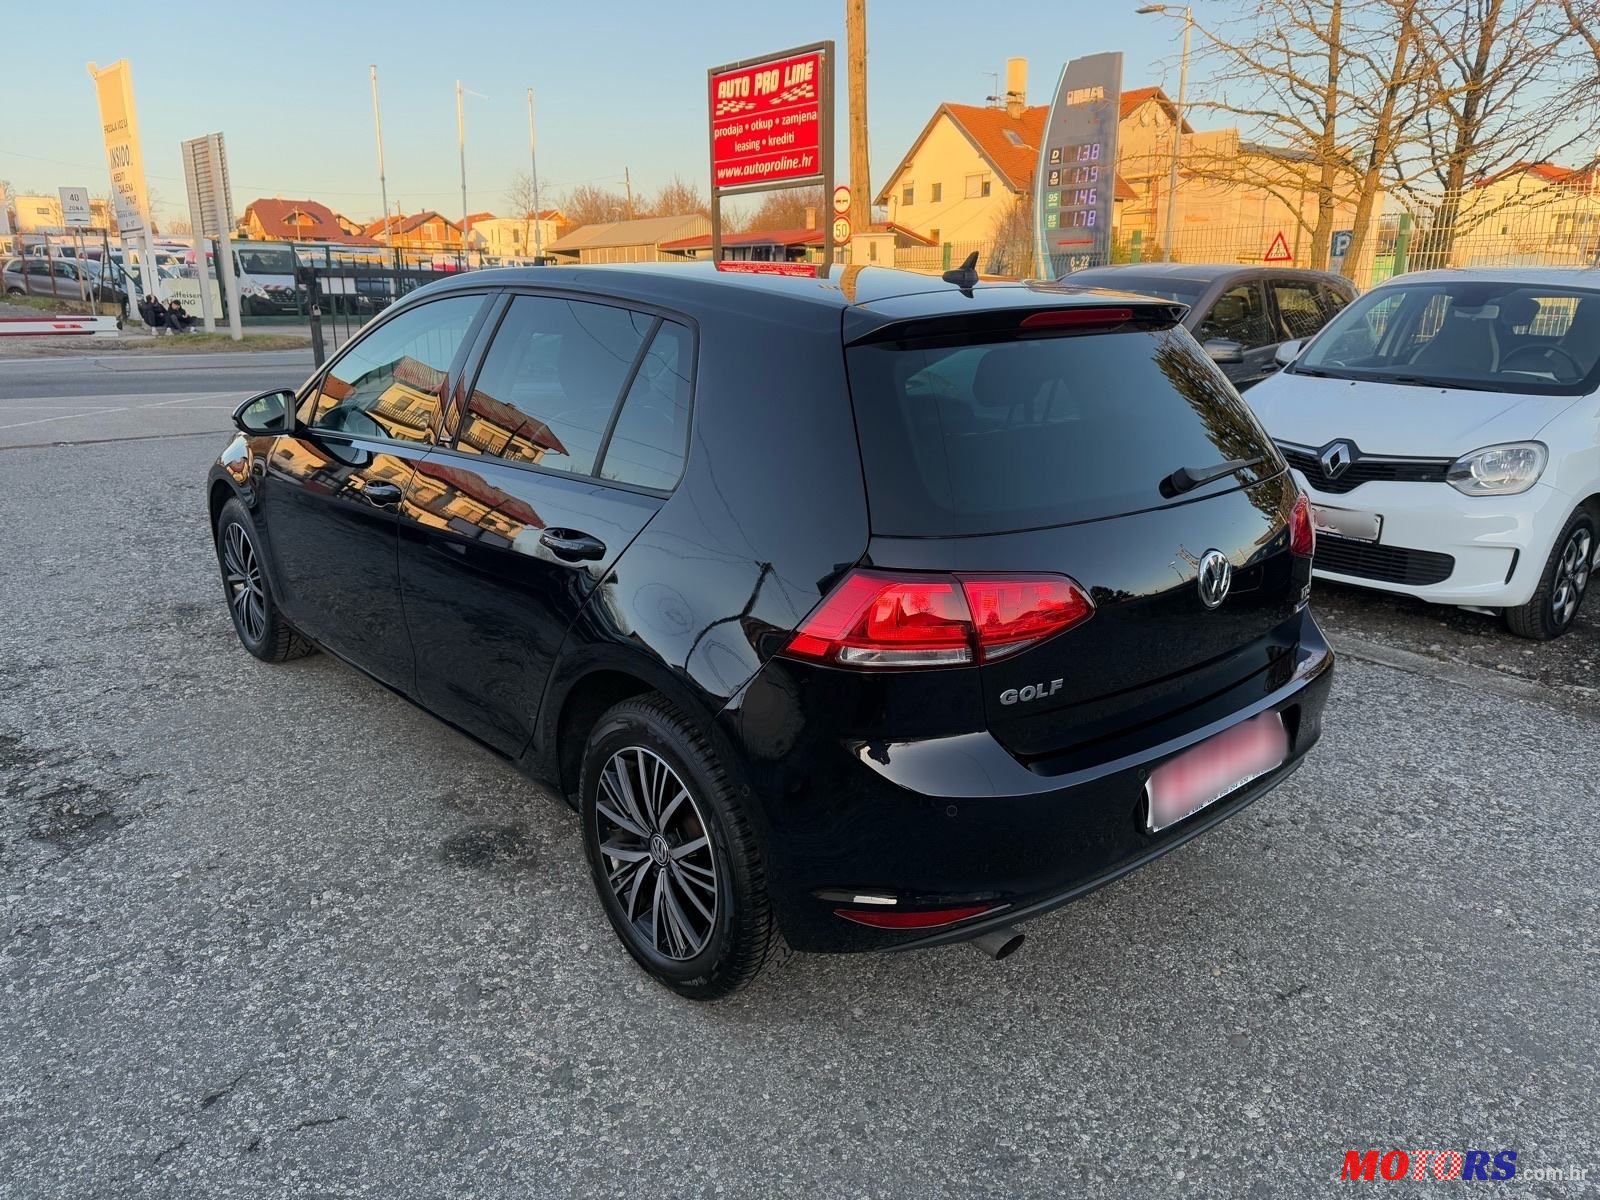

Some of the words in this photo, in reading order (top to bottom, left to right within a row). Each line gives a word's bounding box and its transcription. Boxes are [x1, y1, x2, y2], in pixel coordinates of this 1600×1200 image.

[717, 76, 751, 99] AUTO
[754, 69, 780, 96] PRO
[784, 60, 815, 88] LINE
[714, 123, 744, 140] prodaja
[751, 117, 774, 133] otkup
[782, 110, 817, 126] zamjena
[735, 139, 761, 153] leasing
[768, 131, 795, 147] krediti
[1077, 143, 1100, 161] 1.38
[717, 153, 814, 179] www.autoproline.hr
[1075, 166, 1099, 184] 1.79
[1048, 193, 1059, 202] 95
[1074, 188, 1097, 206] 1.46
[1073, 210, 1097, 227] 1.78
[835, 223, 848, 238] 50
[1335, 235, 1351, 255] P
[999, 678, 1064, 706] GOLF
